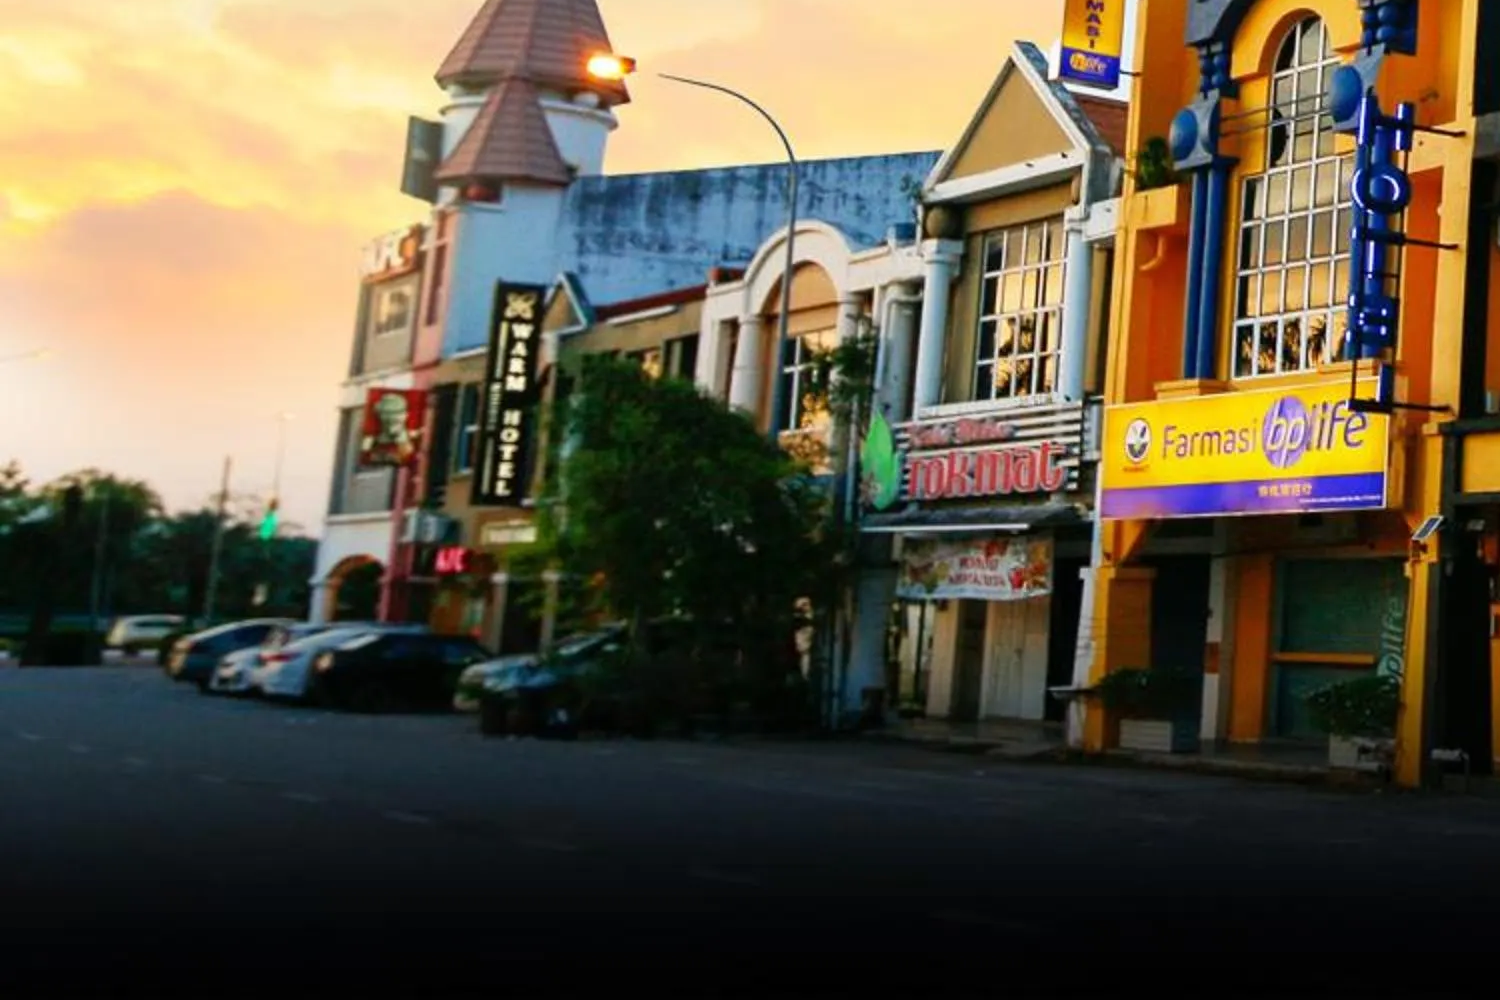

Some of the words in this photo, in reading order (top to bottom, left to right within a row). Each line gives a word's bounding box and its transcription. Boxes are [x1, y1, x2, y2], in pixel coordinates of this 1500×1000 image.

[504, 322, 536, 392] WARM
[494, 409, 524, 497] HOTEL
[1161, 417, 1258, 460] Farmasi
